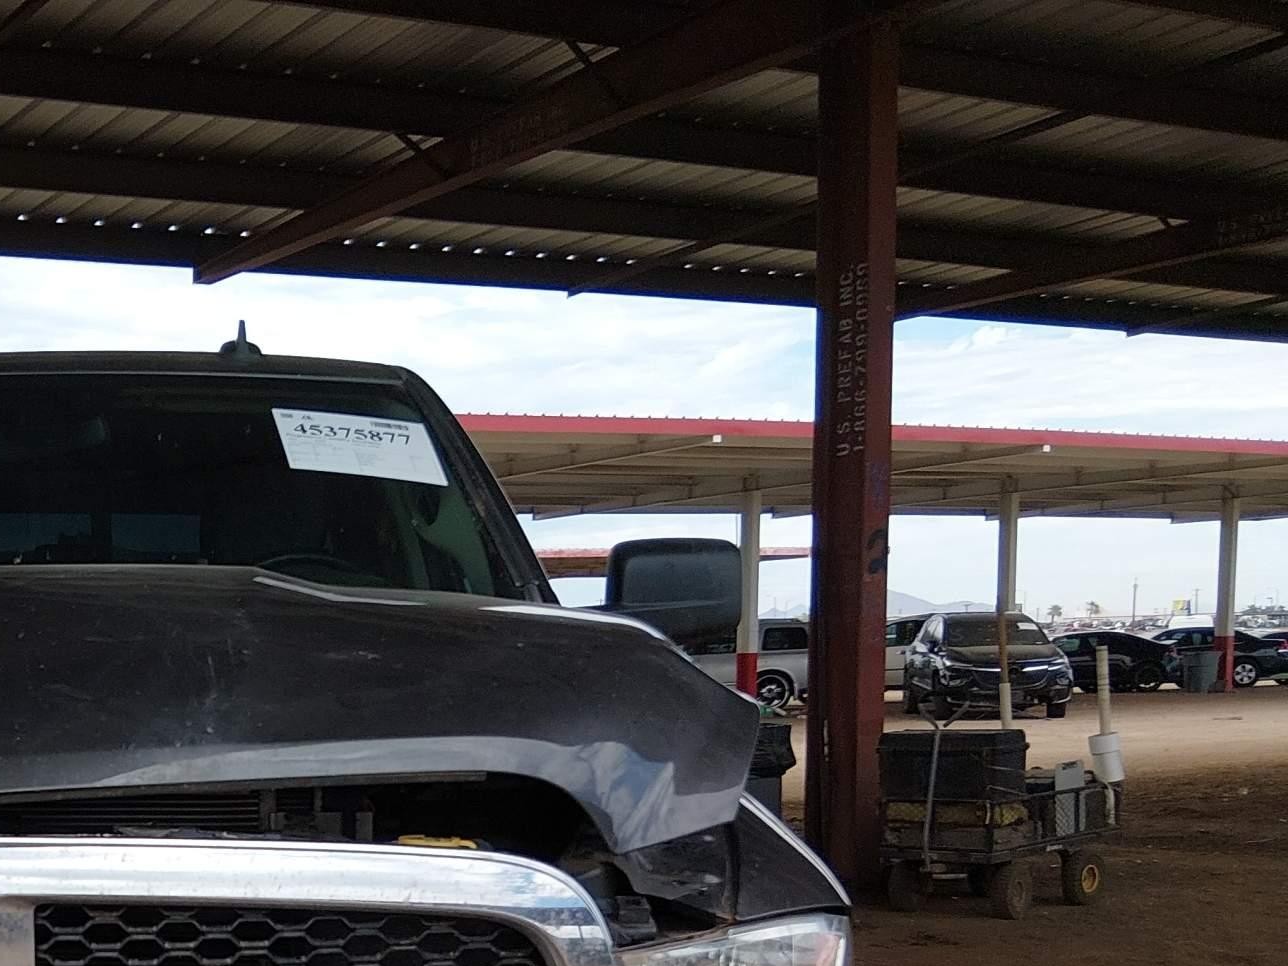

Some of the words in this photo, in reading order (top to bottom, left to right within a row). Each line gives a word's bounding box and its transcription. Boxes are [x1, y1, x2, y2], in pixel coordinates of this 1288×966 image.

[839, 263, 854, 306] INC.
[837, 319, 853, 403] PREFAB
[294, 423, 410, 445] 45375877
